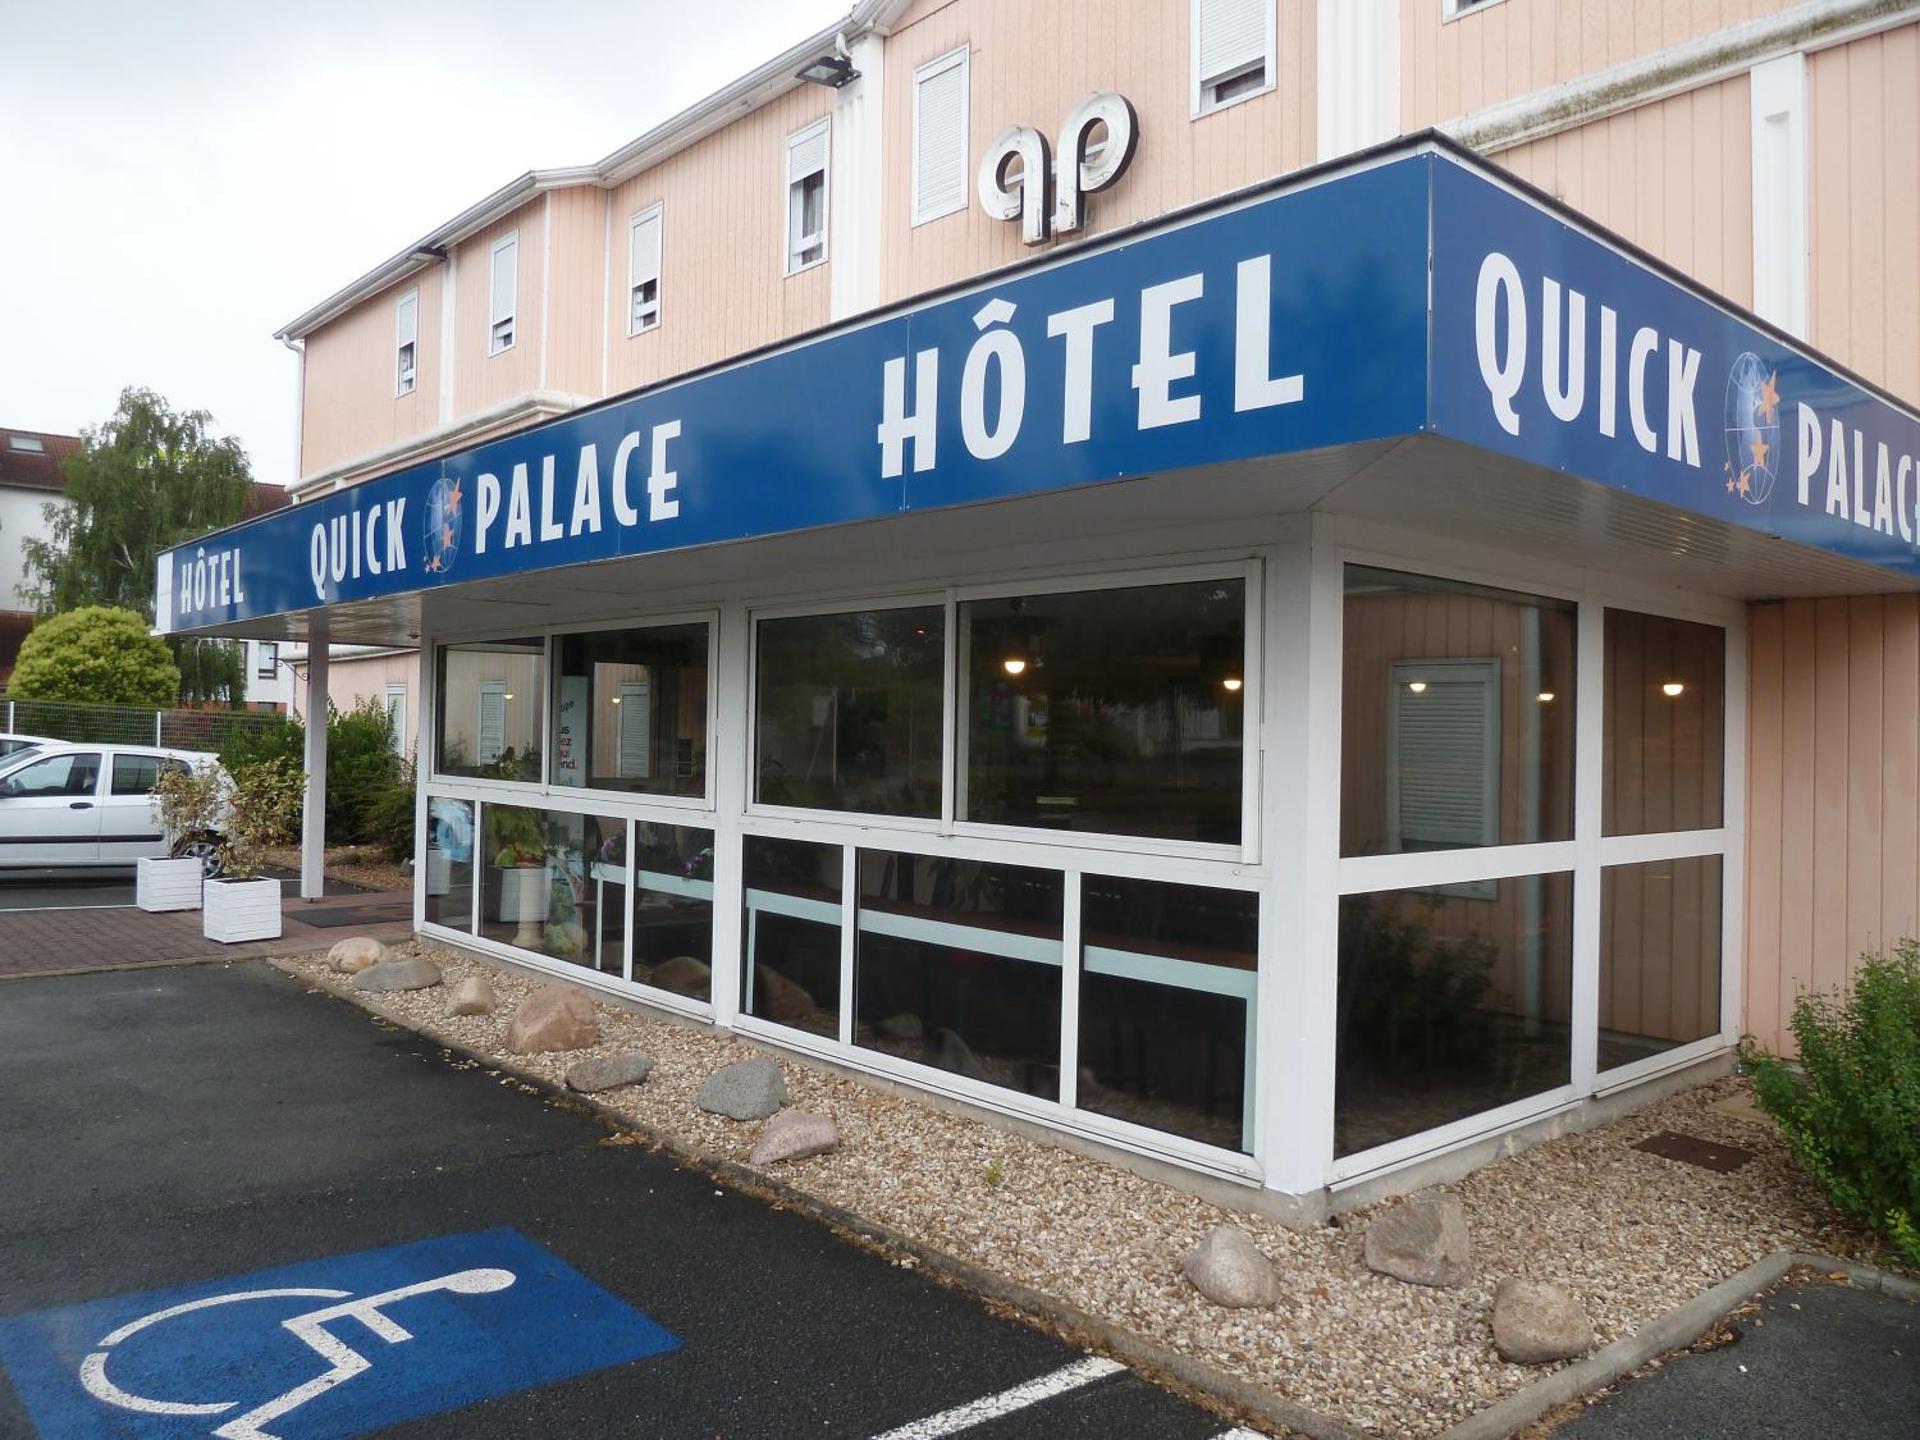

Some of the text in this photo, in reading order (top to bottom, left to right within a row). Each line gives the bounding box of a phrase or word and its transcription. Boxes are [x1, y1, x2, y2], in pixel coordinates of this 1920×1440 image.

[878, 254, 1303, 478] HÔTEL
[1475, 252, 1702, 468] QUICK
[180, 420, 682, 614] HÔTEL QUICK PALACE
